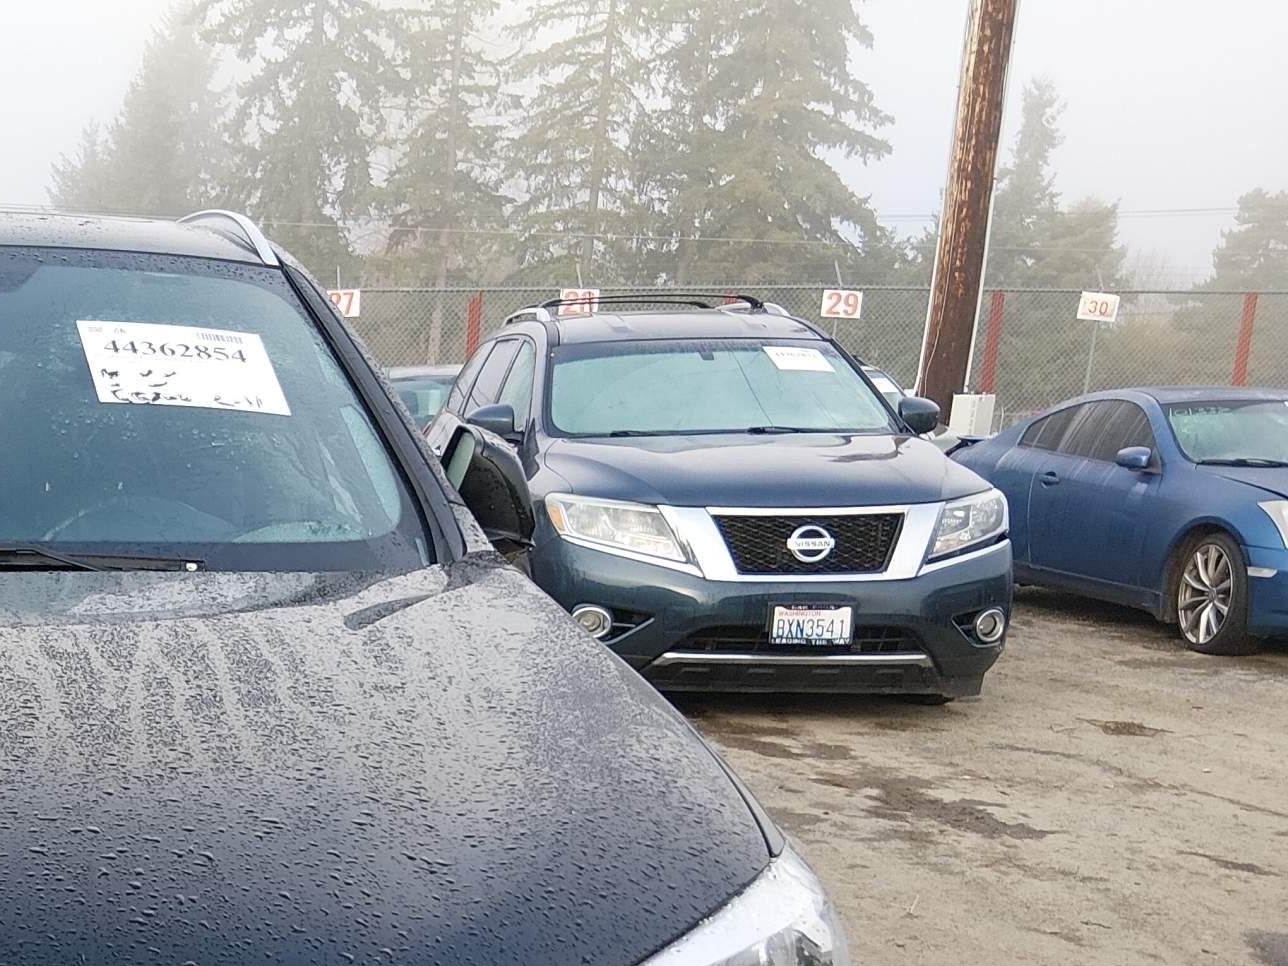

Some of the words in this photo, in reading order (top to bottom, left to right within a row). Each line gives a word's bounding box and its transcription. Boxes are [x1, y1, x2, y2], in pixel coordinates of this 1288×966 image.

[825, 292, 859, 316] 29
[1087, 300, 1109, 315] 30
[103, 339, 247, 363] 44362854
[795, 540, 831, 548] NISSAN
[778, 609, 821, 618] WASHINGTON
[776, 619, 845, 638] BXN3541
